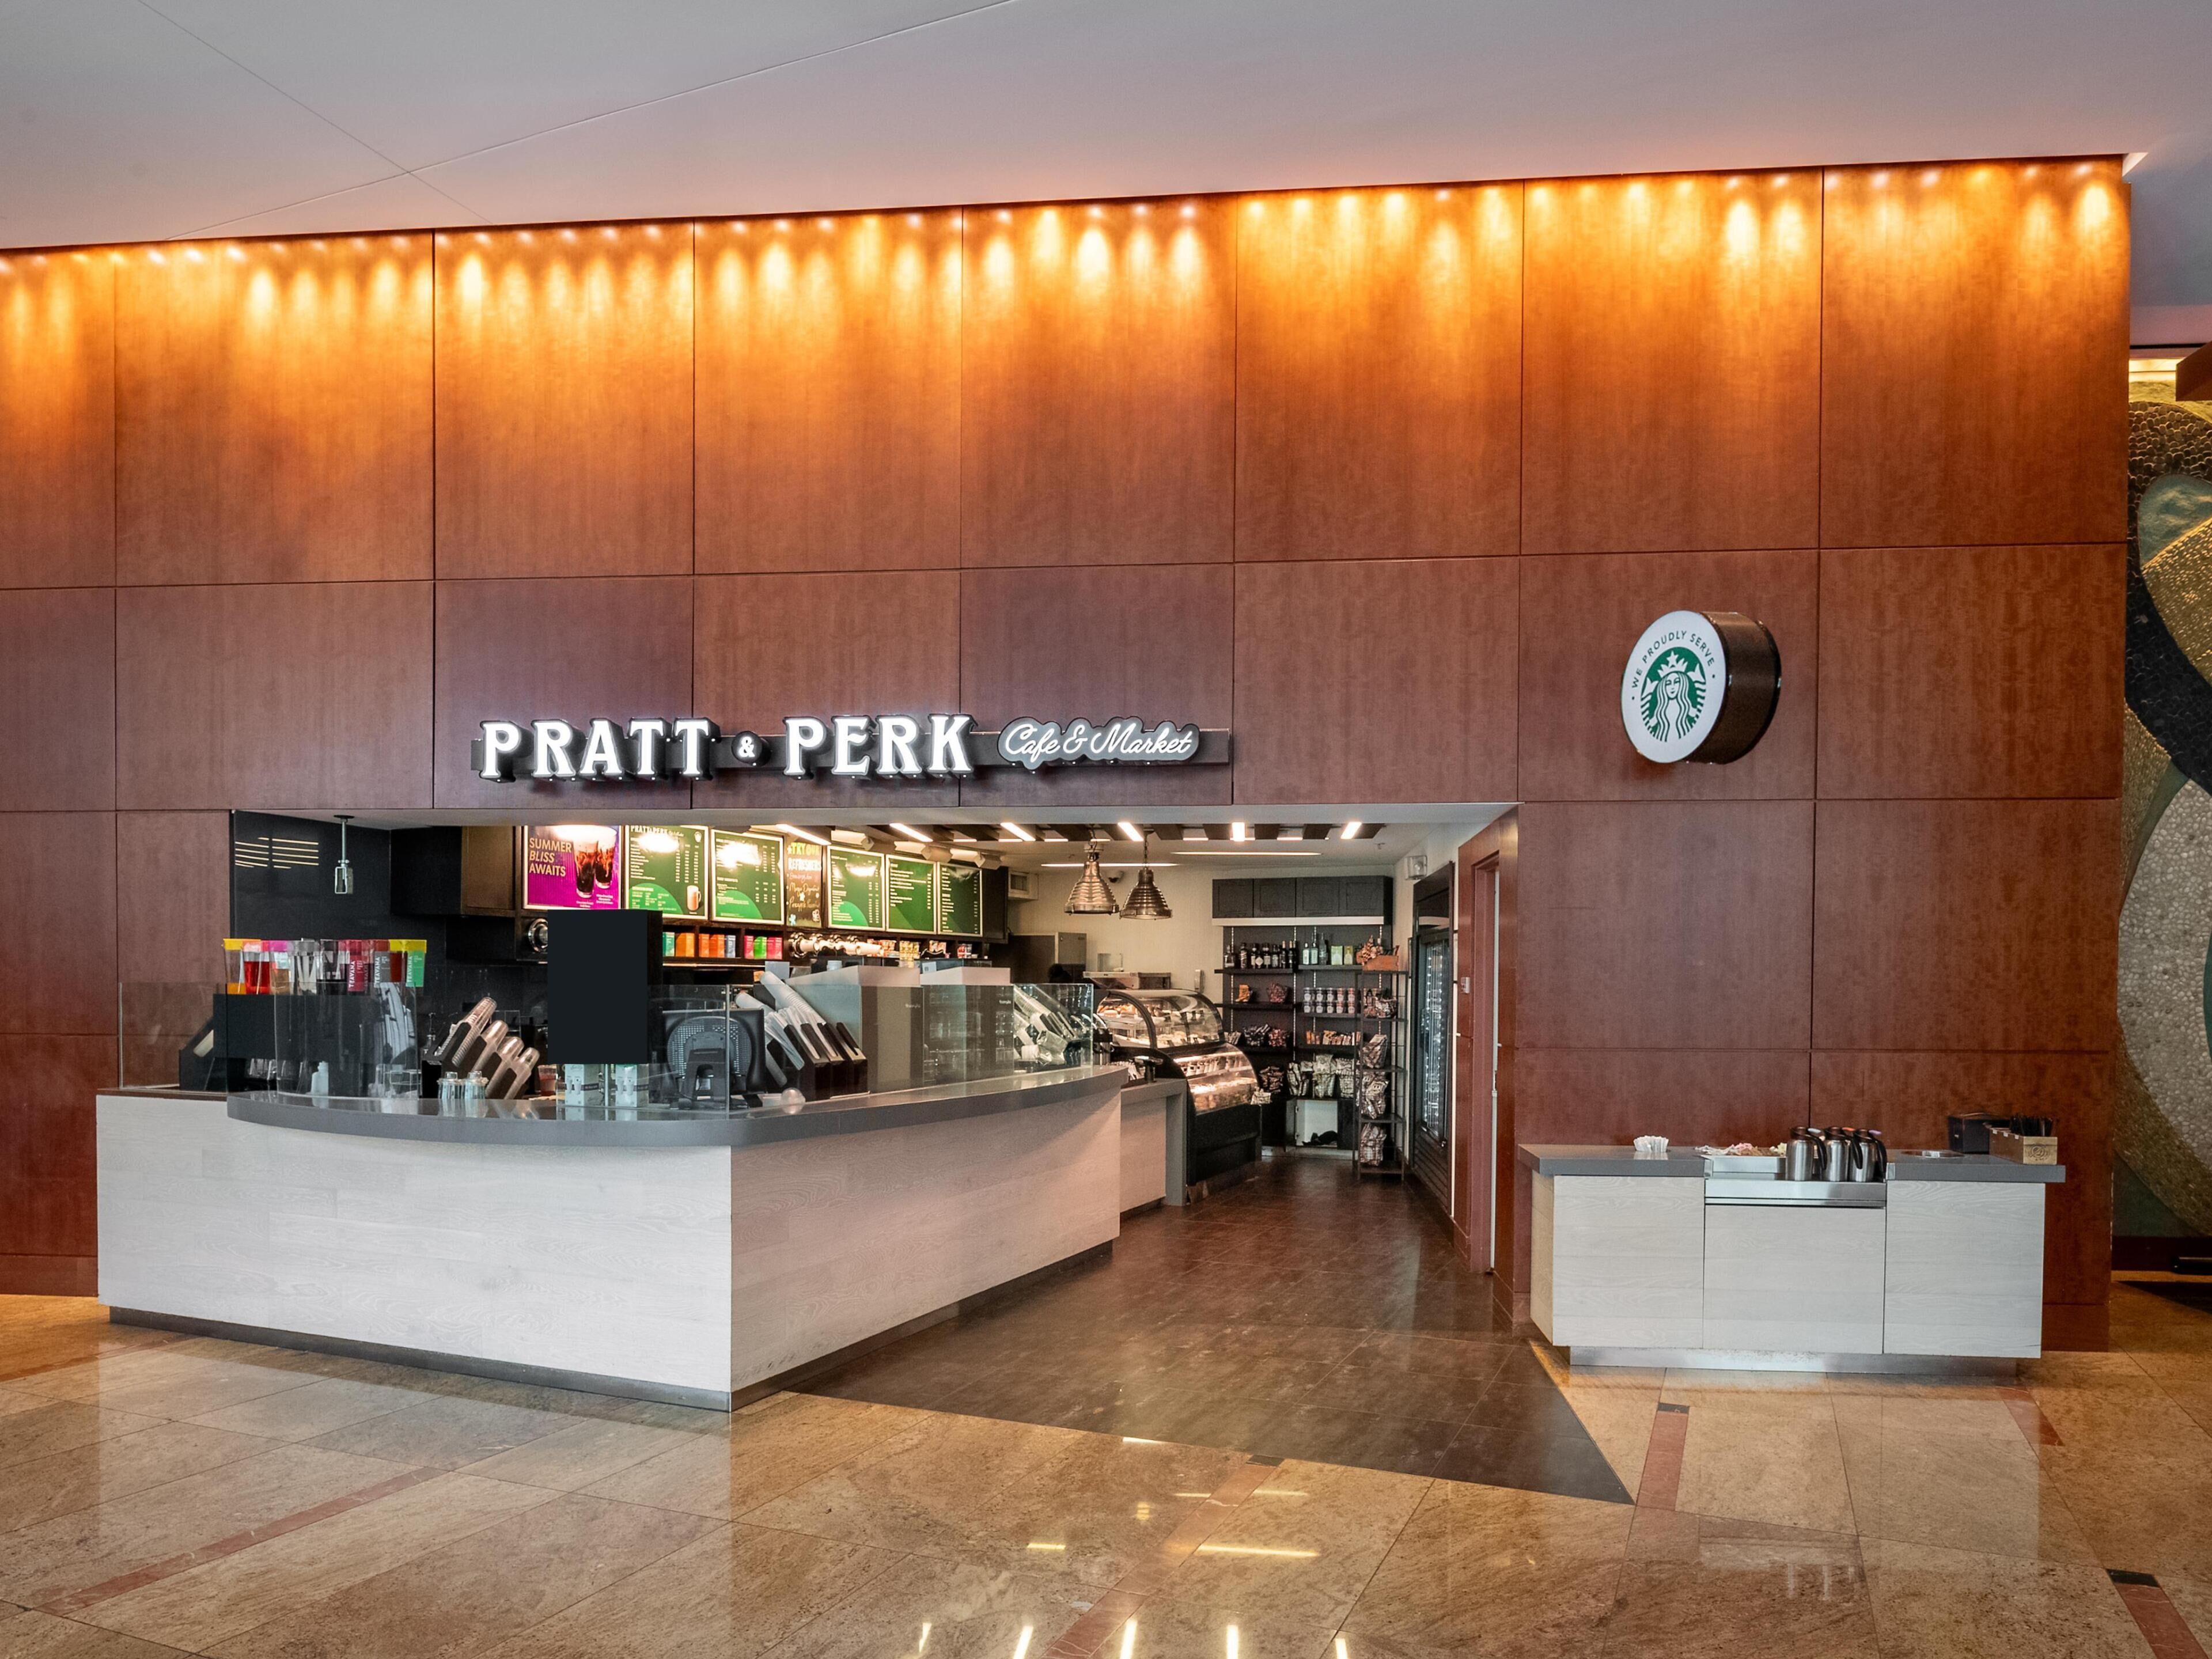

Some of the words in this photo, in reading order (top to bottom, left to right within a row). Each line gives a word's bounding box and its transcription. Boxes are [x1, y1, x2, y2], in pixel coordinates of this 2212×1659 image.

[1631, 668, 1643, 688] WE
[1642, 630, 1687, 664] PROUDLY
[1690, 633, 1715, 667] SERVE
[482, 719, 709, 777] PRATT
[738, 736, 755, 757] &
[785, 716, 973, 774] PERK
[1005, 724, 1061, 763] Cafe
[1063, 725, 1088, 753] &
[1090, 723, 1192, 753] Market
[529, 838, 572, 853] SUMMER
[791, 842, 806, 855] TRY
[529, 850, 555, 863] BLISS
[529, 863, 566, 877] AWAITS
